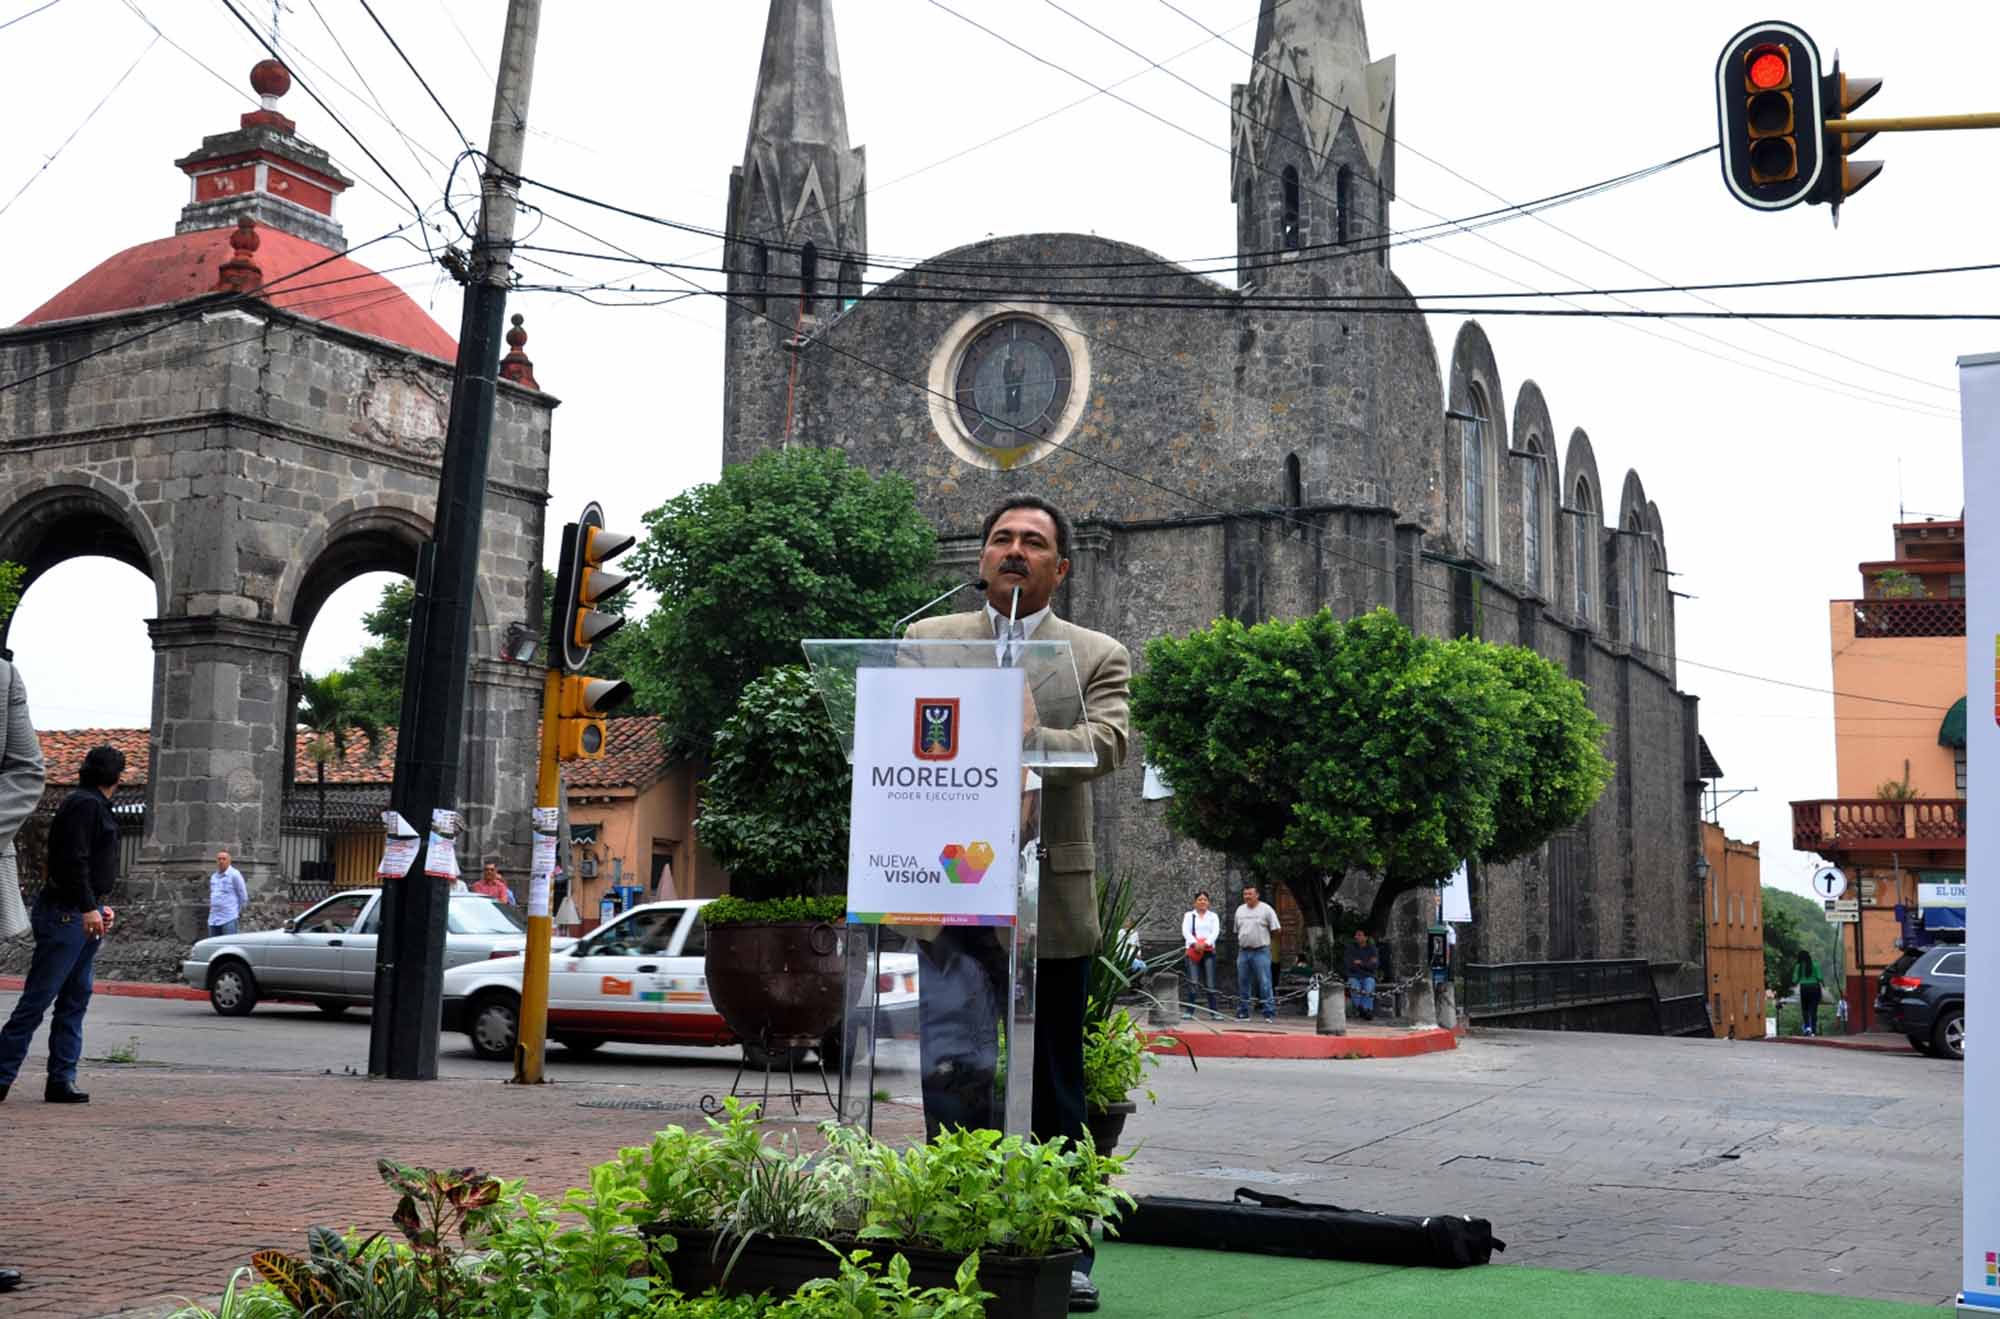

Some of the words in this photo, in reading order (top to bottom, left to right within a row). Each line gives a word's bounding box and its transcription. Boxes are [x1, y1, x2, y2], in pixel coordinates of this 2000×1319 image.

[872, 766, 998, 788] MORELOS
[887, 791, 921, 801] PODER
[926, 791, 980, 802] EJECUTIVO
[869, 854, 919, 868] NUEVA
[884, 867, 941, 884] VISIÓN
